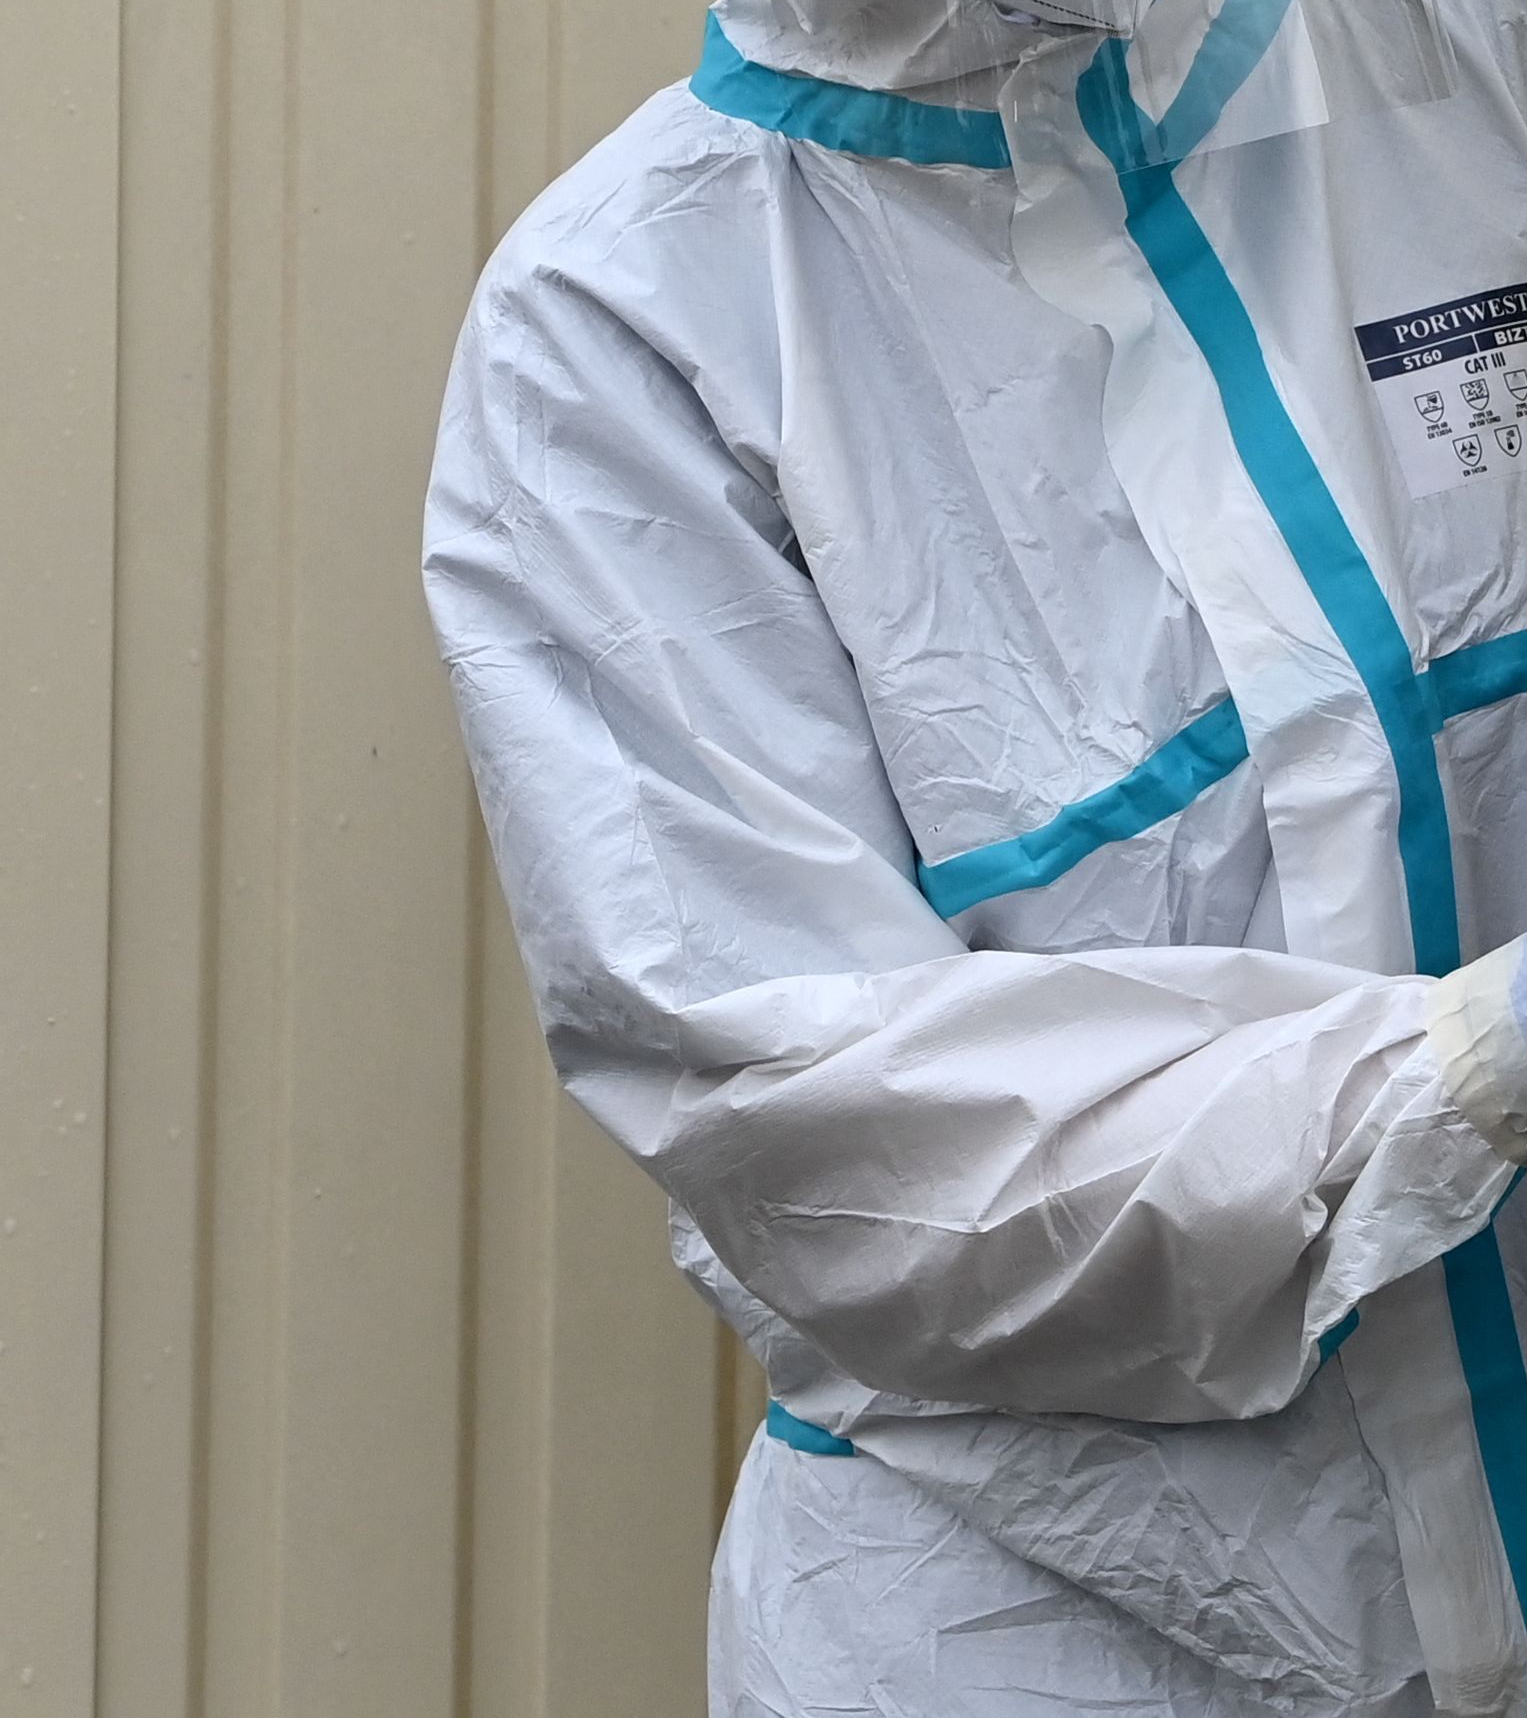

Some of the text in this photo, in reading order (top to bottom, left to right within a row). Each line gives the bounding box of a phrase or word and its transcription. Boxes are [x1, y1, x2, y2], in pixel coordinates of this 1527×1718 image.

[1402, 349, 1443, 371] ST60
[1463, 350, 1508, 376] CAT III
